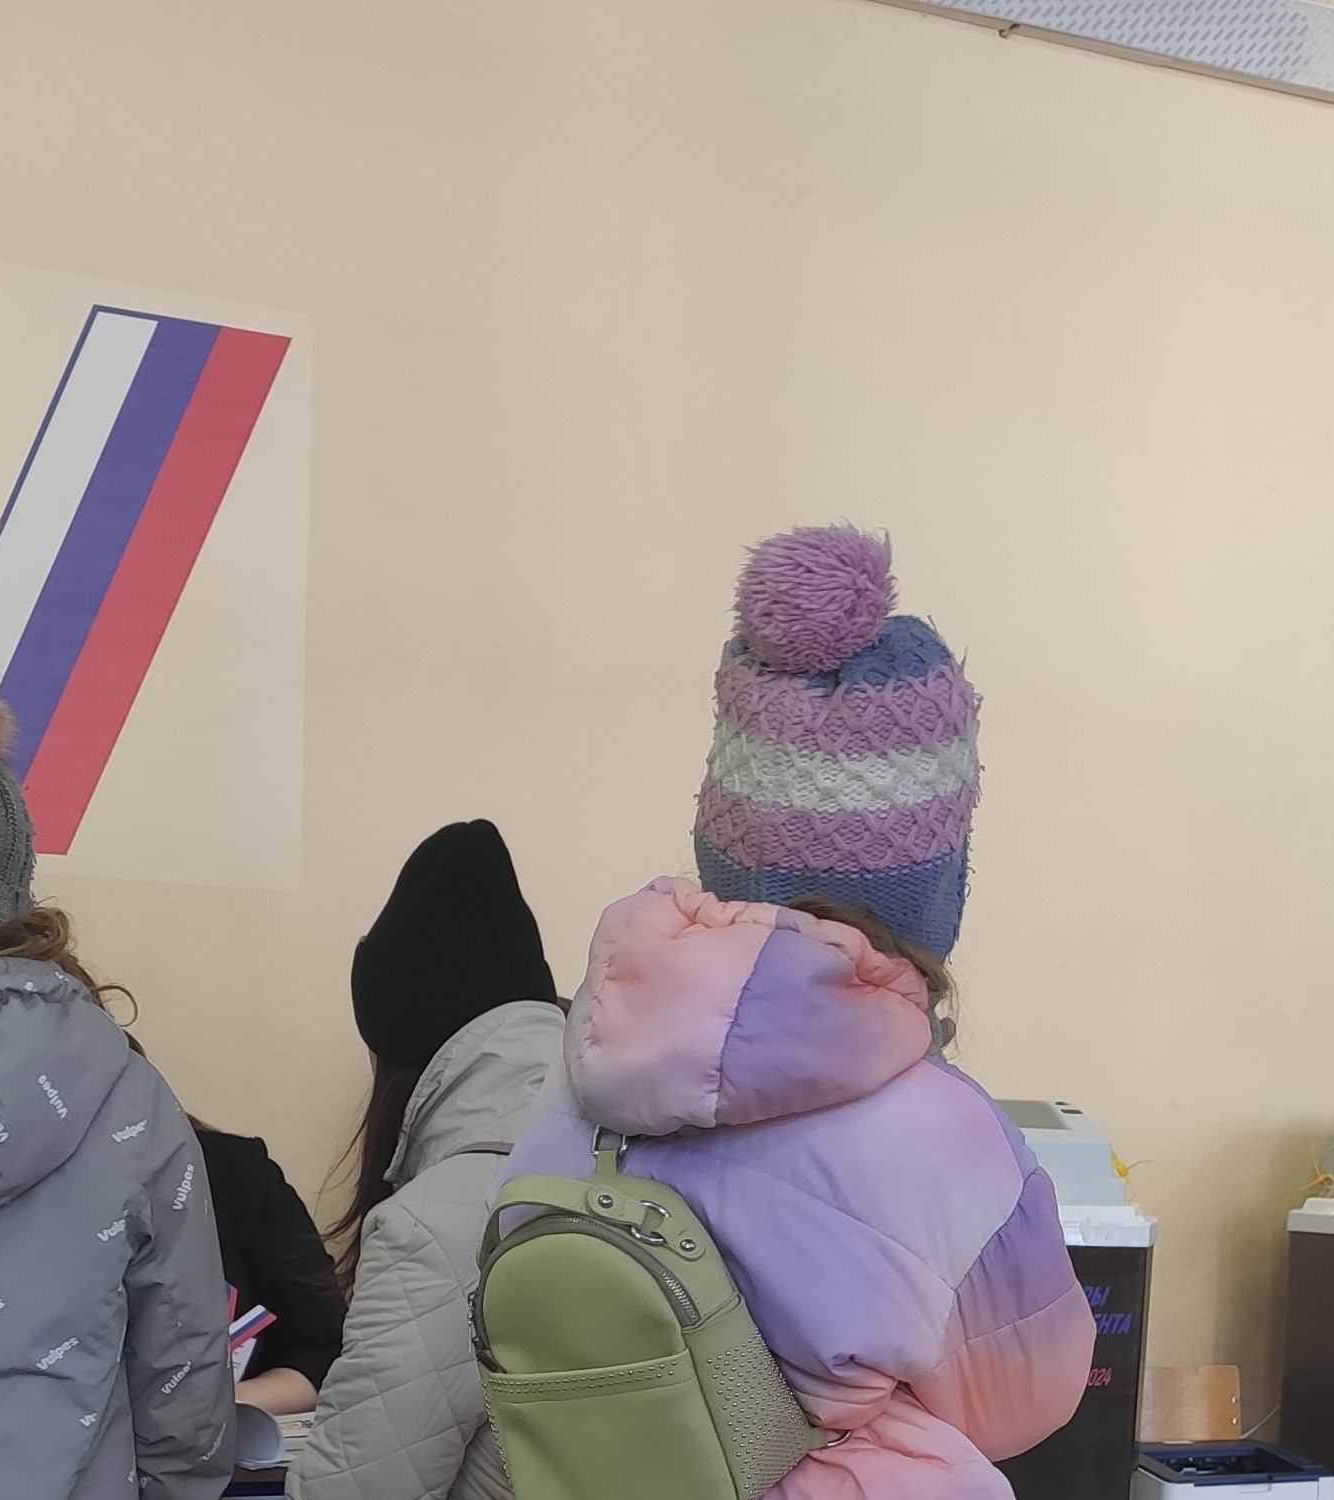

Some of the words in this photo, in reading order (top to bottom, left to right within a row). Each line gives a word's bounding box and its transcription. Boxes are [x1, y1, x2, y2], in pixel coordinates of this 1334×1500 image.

[171, 1163, 195, 1211] Vulpes
[36, 1336, 80, 1371] Vulpes
[1088, 1367, 1112, 1386] 024
